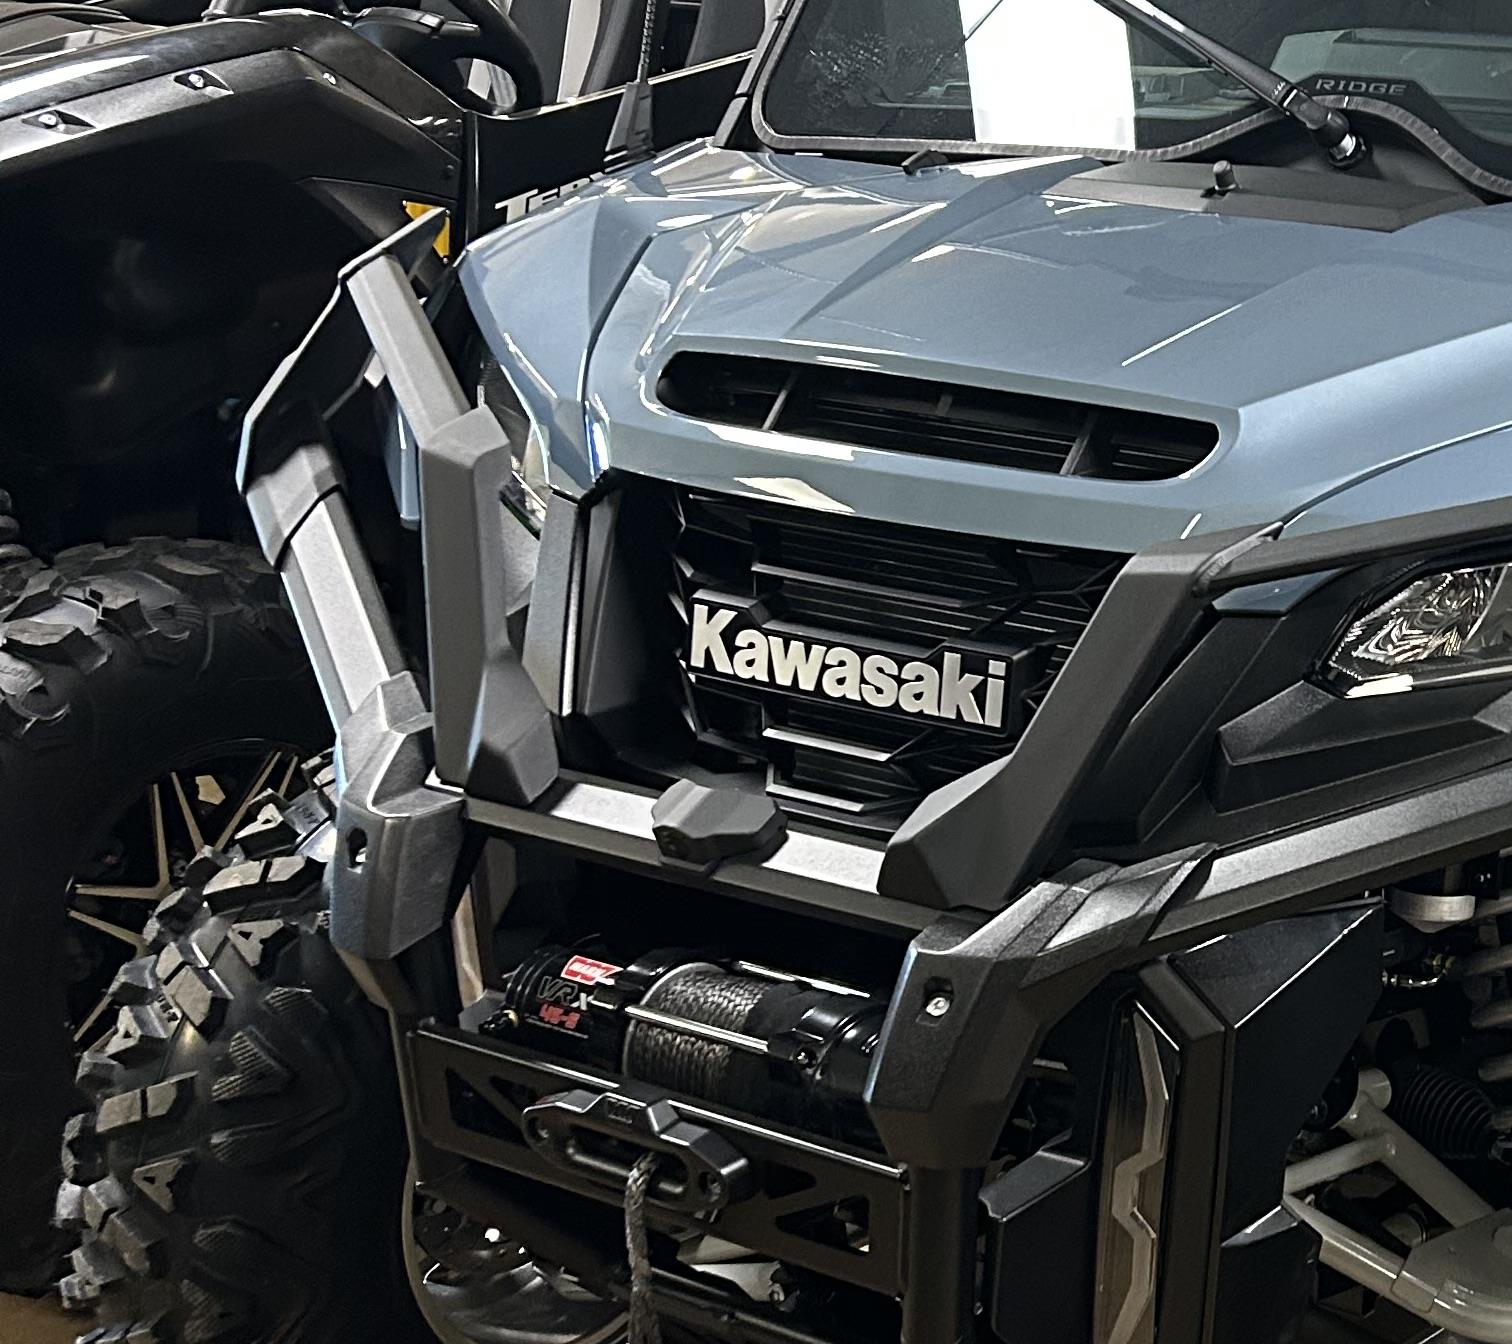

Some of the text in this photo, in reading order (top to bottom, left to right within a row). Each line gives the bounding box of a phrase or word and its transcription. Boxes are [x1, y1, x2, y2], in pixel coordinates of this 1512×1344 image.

[1315, 78, 1407, 95] RIDGE
[495, 172, 604, 224] TER
[691, 603, 1005, 728] Kawasaki
